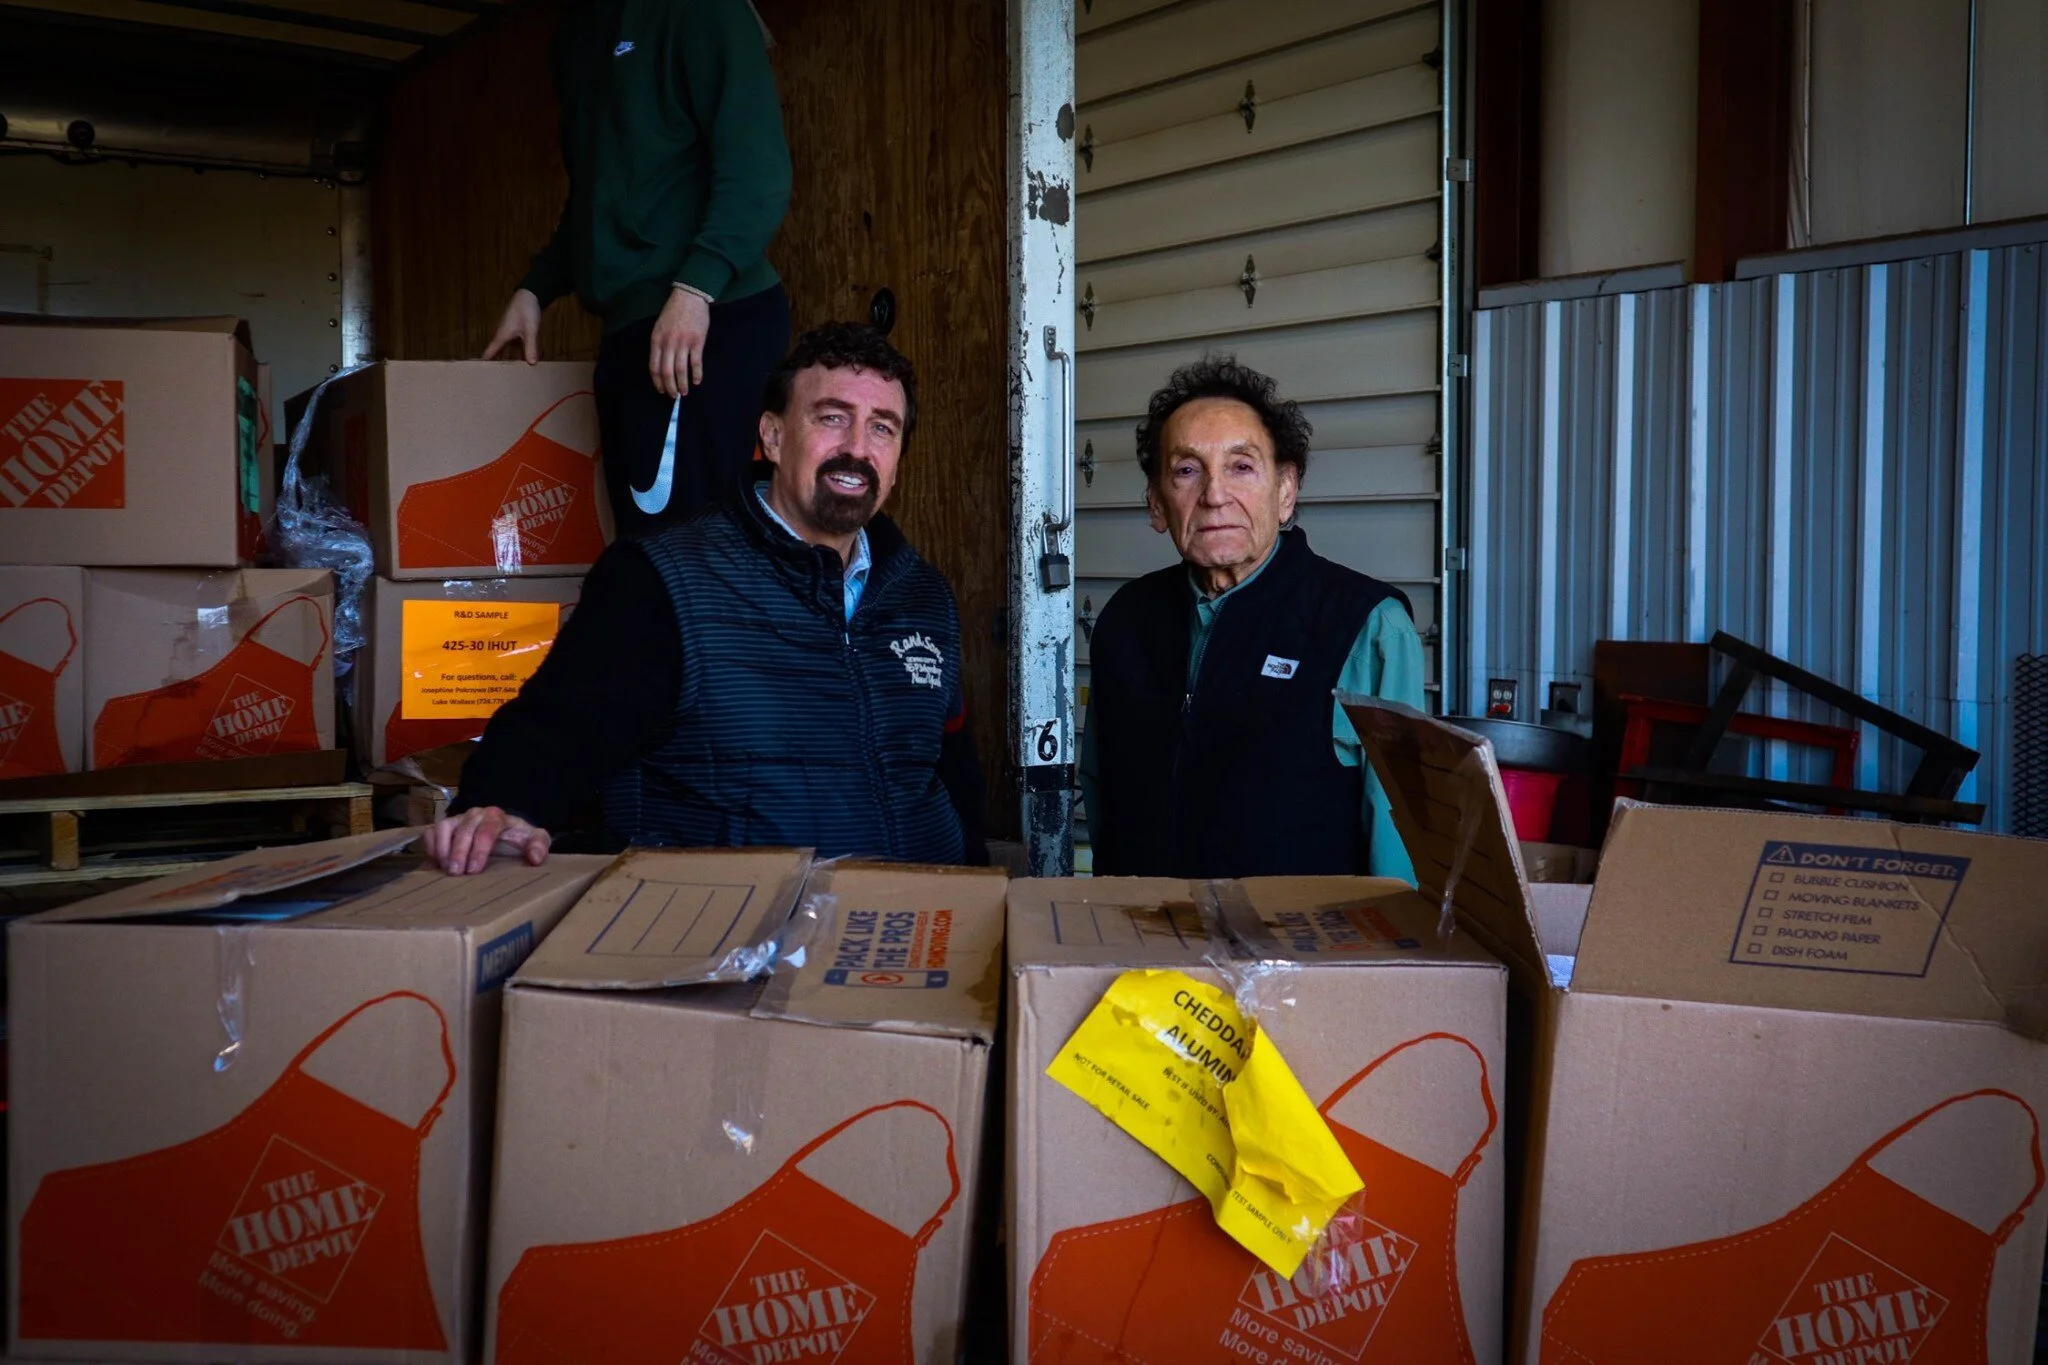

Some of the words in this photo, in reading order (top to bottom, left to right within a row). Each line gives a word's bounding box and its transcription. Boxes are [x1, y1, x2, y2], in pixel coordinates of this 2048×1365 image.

[0, 392, 58, 443] THE
[0, 380, 124, 508] HOME
[43, 428, 124, 508] DEPOT
[501, 483, 572, 521] HOME
[517, 479, 546, 497] THE
[521, 507, 564, 531] DEPOT
[454, 610, 473, 619] R&D
[475, 611, 509, 620] SAMPLE
[442, 640, 484, 651] 425-30
[487, 640, 517, 651] IHUT
[441, 673, 455, 681] For
[457, 673, 498, 683] questions,
[500, 673, 517, 681] call:
[212, 695, 290, 737] HOME
[231, 690, 261, 710] THE
[234, 719, 281, 746] DEPOT
[1037, 720, 1057, 761] 6
[1800, 852, 1868, 869] DON'T
[1794, 874, 1840, 887] BUBBLE
[1845, 877, 1909, 892] CUSHION
[1783, 909, 1840, 923] STRETCH
[1842, 913, 1872, 926] FILM
[1789, 892, 1850, 906] MOVING
[1852, 896, 1920, 911] BLANKETS
[844, 911, 878, 934] LIKE
[879, 912, 915, 943] PROS
[1777, 927, 1838, 941] PACKING
[1841, 932, 1882, 944] PAPER
[834, 938, 872, 968] PACK
[873, 948, 908, 968] THE
[1772, 945, 1803, 957] DISH
[1806, 948, 1848, 961] FOAM
[1166, 1025, 1237, 1083] ALUMIN
[1074, 1053, 1092, 1066] NOT
[1091, 1064, 1107, 1077] FOR
[1106, 1075, 1131, 1097] RETAIL
[1131, 1093, 1151, 1111] SALE
[1162, 1067, 1182, 1084] BEST
[1188, 1088, 1208, 1107] USED
[262, 1170, 319, 1204] THE
[229, 1180, 376, 1256] HOME
[1232, 1190, 1248, 1206] TEST
[1247, 1203, 1273, 1229] SAMPLE
[268, 1229, 354, 1276] DEPOT
[208, 1251, 254, 1286] More
[255, 1280, 317, 1323] saving.
[750, 1267, 809, 1298] THE
[1253, 1231, 1407, 1313] HOME
[1813, 1271, 1878, 1306] THE
[198, 1270, 245, 1305] More
[246, 1300, 299, 1339] doing.
[714, 1283, 865, 1347] HOME
[1294, 1281, 1387, 1331] DEPOT
[1773, 1285, 1935, 1359] HOME
[1229, 1307, 1279, 1344] More
[752, 1329, 842, 1365] DEPOT
[1219, 1328, 1268, 1365] More
